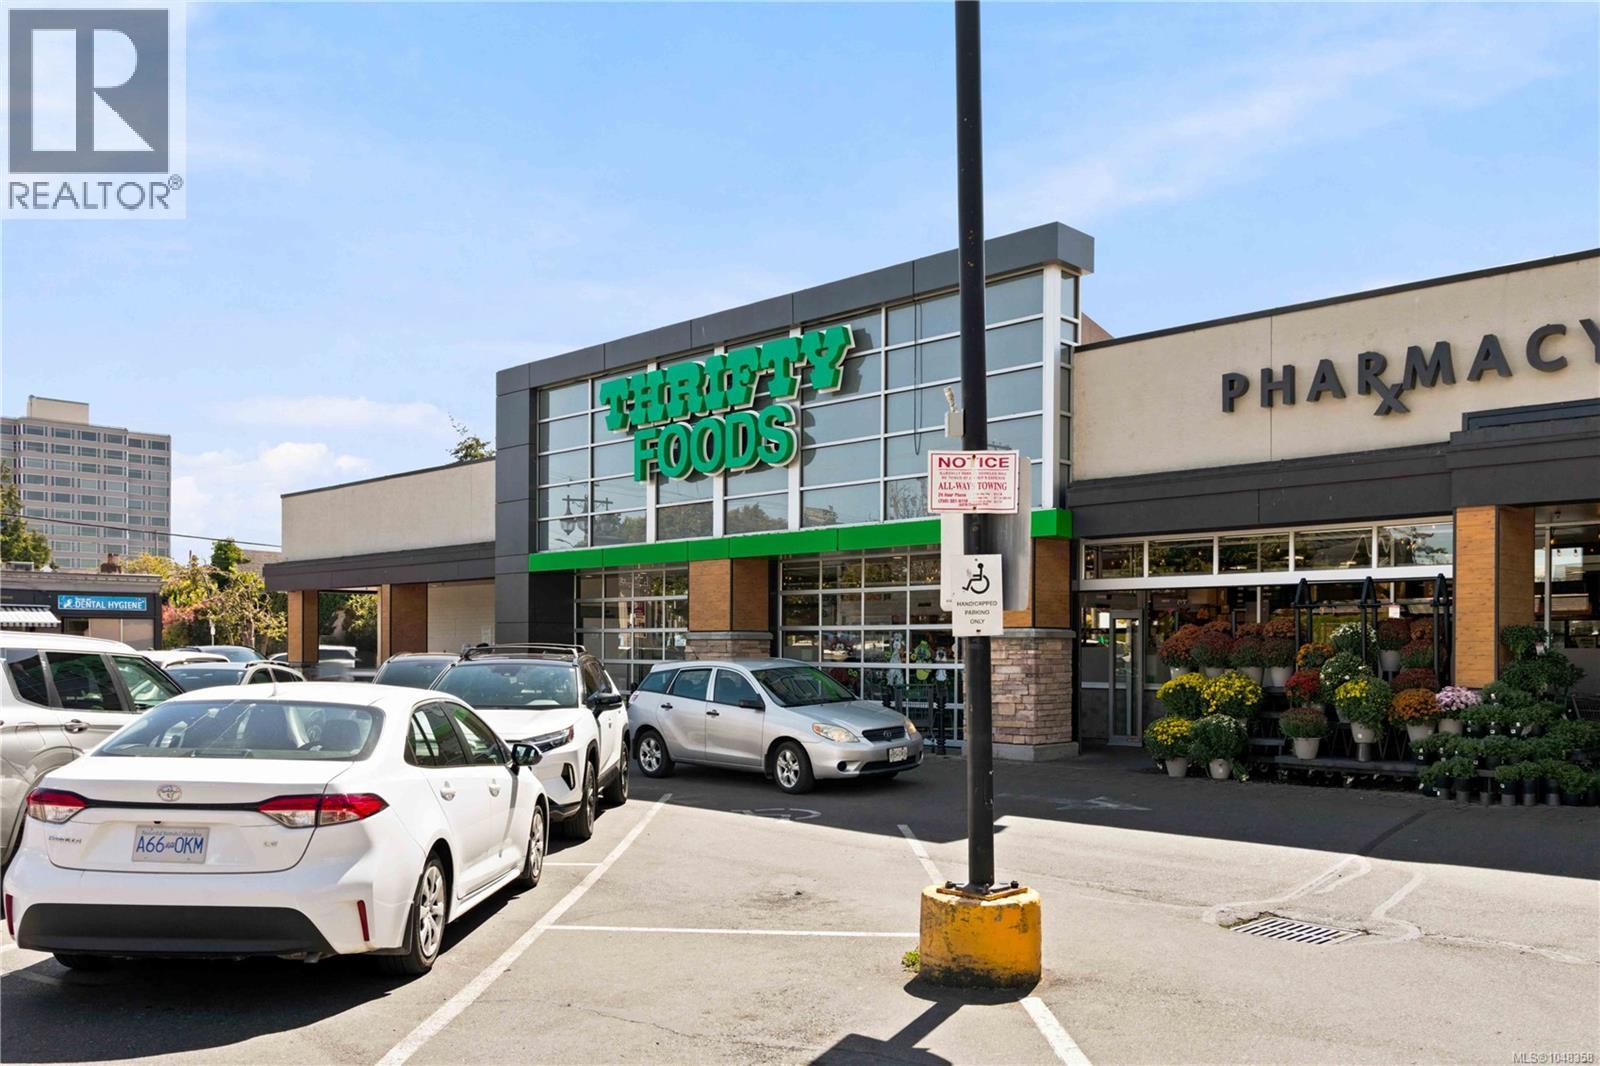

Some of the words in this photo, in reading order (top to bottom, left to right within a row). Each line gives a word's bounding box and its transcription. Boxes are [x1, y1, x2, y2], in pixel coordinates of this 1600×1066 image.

[600, 324, 856, 433] THRIFTY
[634, 403, 797, 484] FOODS
[938, 482, 971, 490] ALL-WAY
[977, 482, 1007, 490] TOWING
[75, 600, 107, 609] DENTAL
[107, 600, 143, 609] HYGIENE
[136, 836, 165, 853] A66
